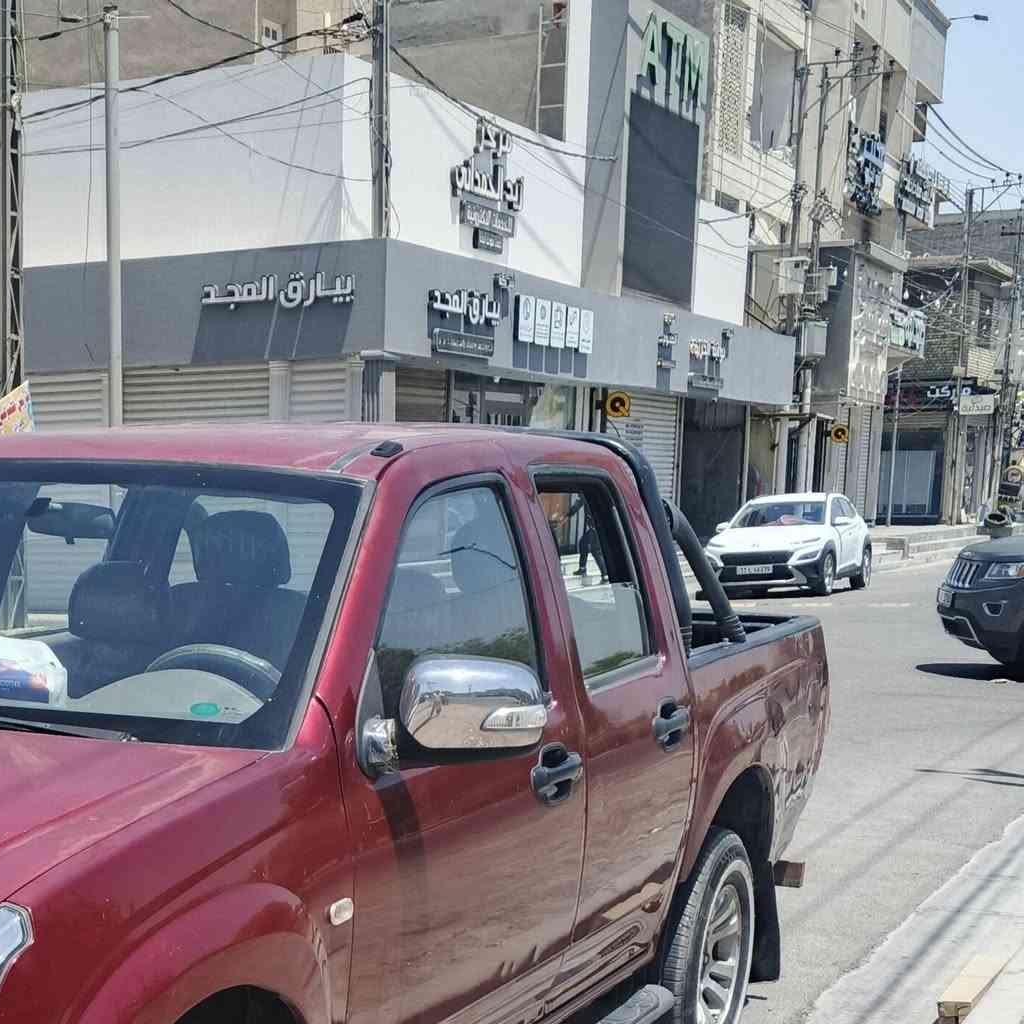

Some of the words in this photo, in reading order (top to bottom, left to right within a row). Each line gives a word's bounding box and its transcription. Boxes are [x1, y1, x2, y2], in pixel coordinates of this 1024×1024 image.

[639, 11, 710, 108] ATM
[479, 125, 512, 157] مركز
[201, 274, 277, 310] المجد
[279, 272, 355, 309] بيارق
[432, 288, 467, 320] المجد
[468, 289, 501, 326] بيارق
[927, 384, 972, 402] مركت
